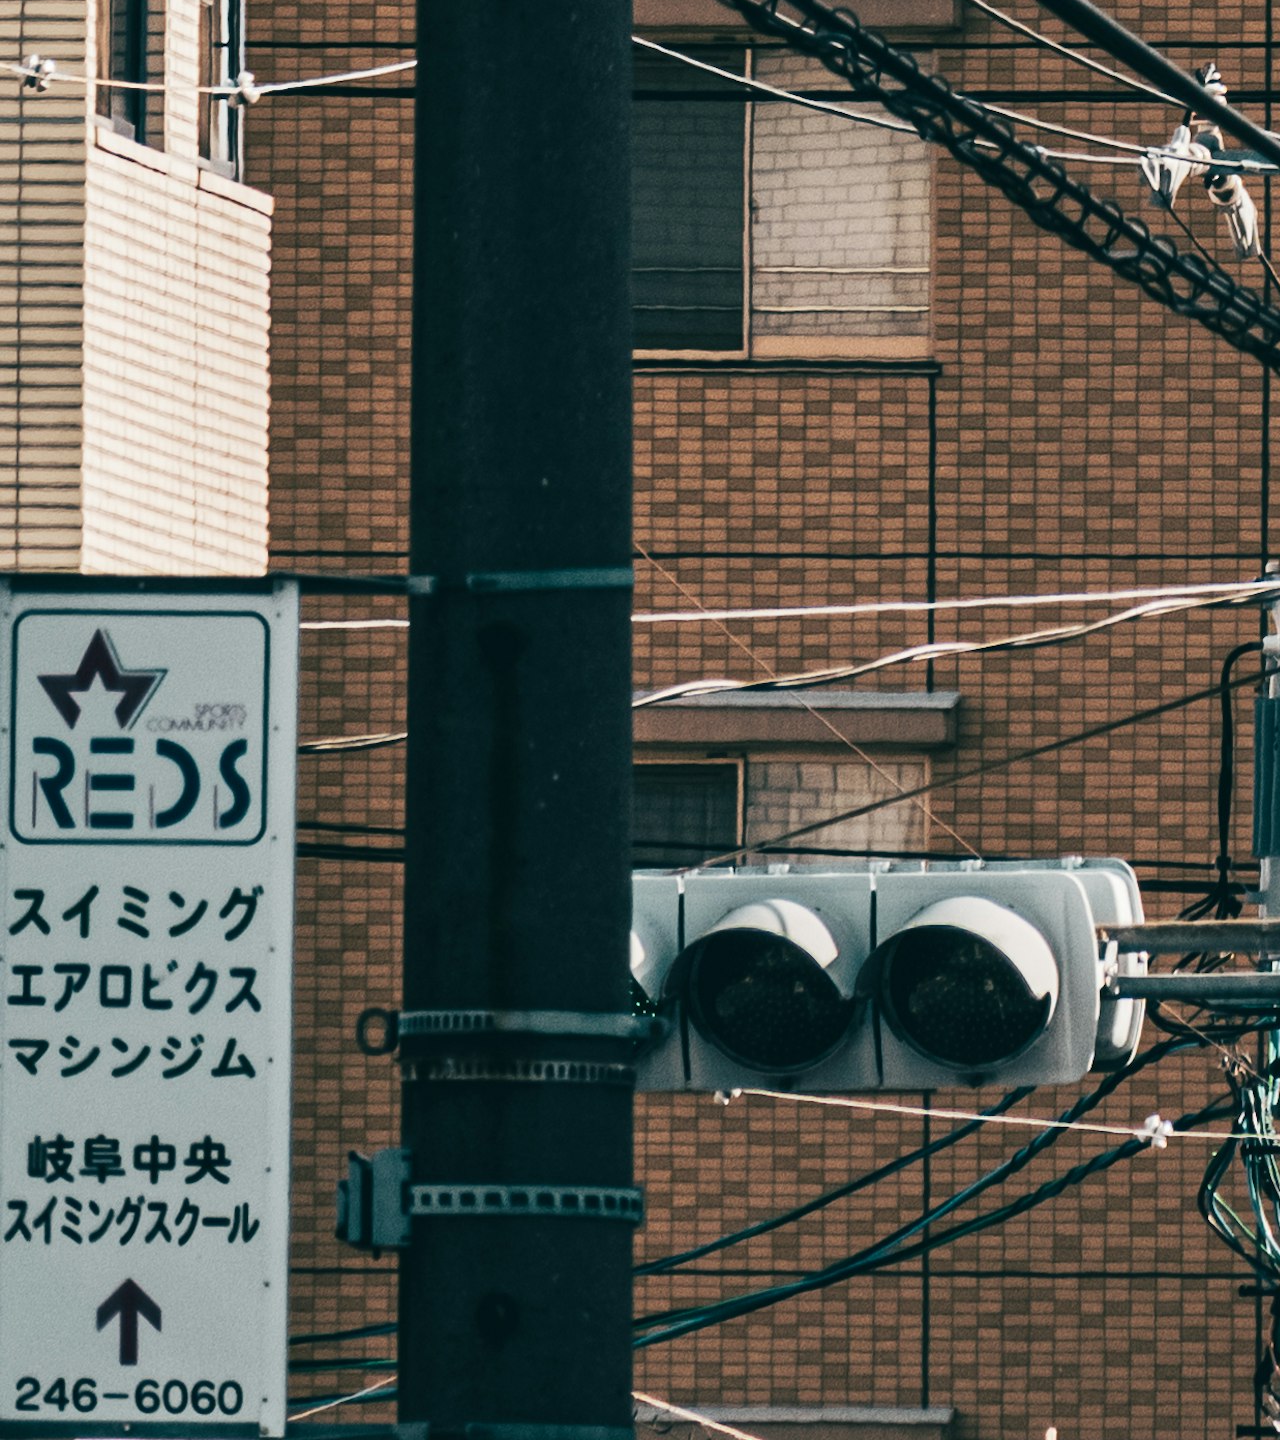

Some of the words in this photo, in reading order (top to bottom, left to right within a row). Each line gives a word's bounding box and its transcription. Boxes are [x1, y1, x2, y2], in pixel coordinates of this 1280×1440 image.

[145, 717, 247, 733] COMMUNITY
[32, 736, 252, 830] REDS
[8, 884, 265, 942] スイミング
[7, 959, 262, 1015] エアロビクス
[7, 1033, 257, 1080] マシンジム
[26, 1133, 232, 1185] 岐阜中央
[3, 1194, 261, 1247] スイミングスクール
[14, 1376, 244, 1416] 246-6060
